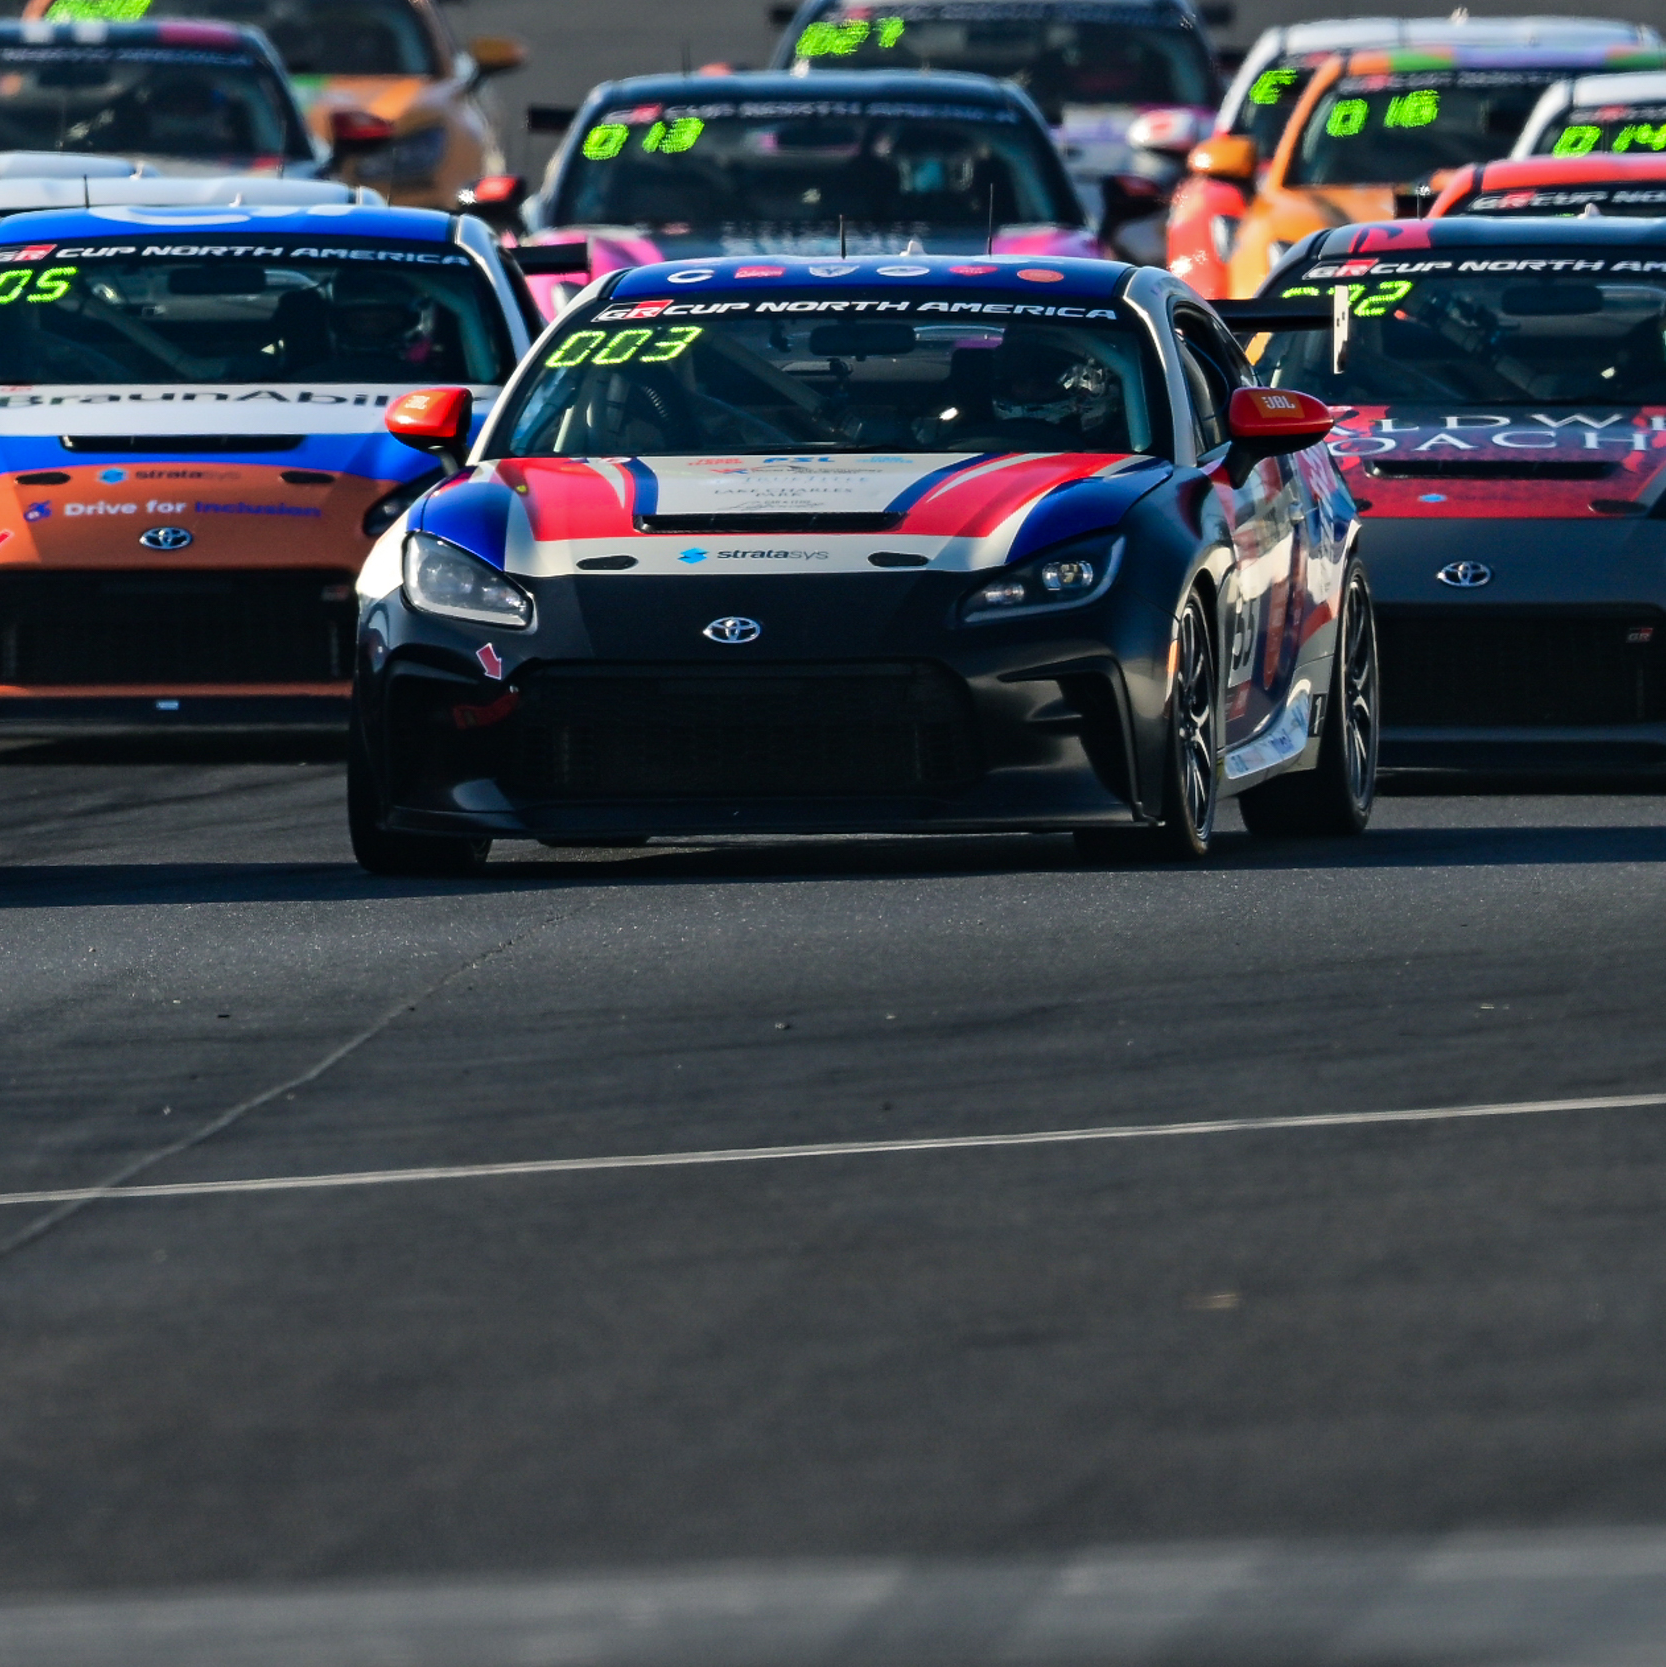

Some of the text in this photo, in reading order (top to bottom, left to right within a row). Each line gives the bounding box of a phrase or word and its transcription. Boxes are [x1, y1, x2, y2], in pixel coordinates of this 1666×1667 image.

[55, 245, 136, 260] CUP
[141, 244, 285, 258] NORTH
[290, 246, 472, 266] AMERICA
[1370, 262, 1452, 275] CUP
[1458, 260, 1605, 272] NORTH
[661, 302, 749, 317] CUP
[755, 301, 911, 314] NORTH
[915, 301, 1118, 321] AMERICA
[546, 326, 704, 368] 003
[1261, 395, 1296, 410] JBL
[135, 468, 241, 481] stratasys
[63, 499, 322, 518] Drive for Inclusion
[717, 548, 829, 562] stratasys
